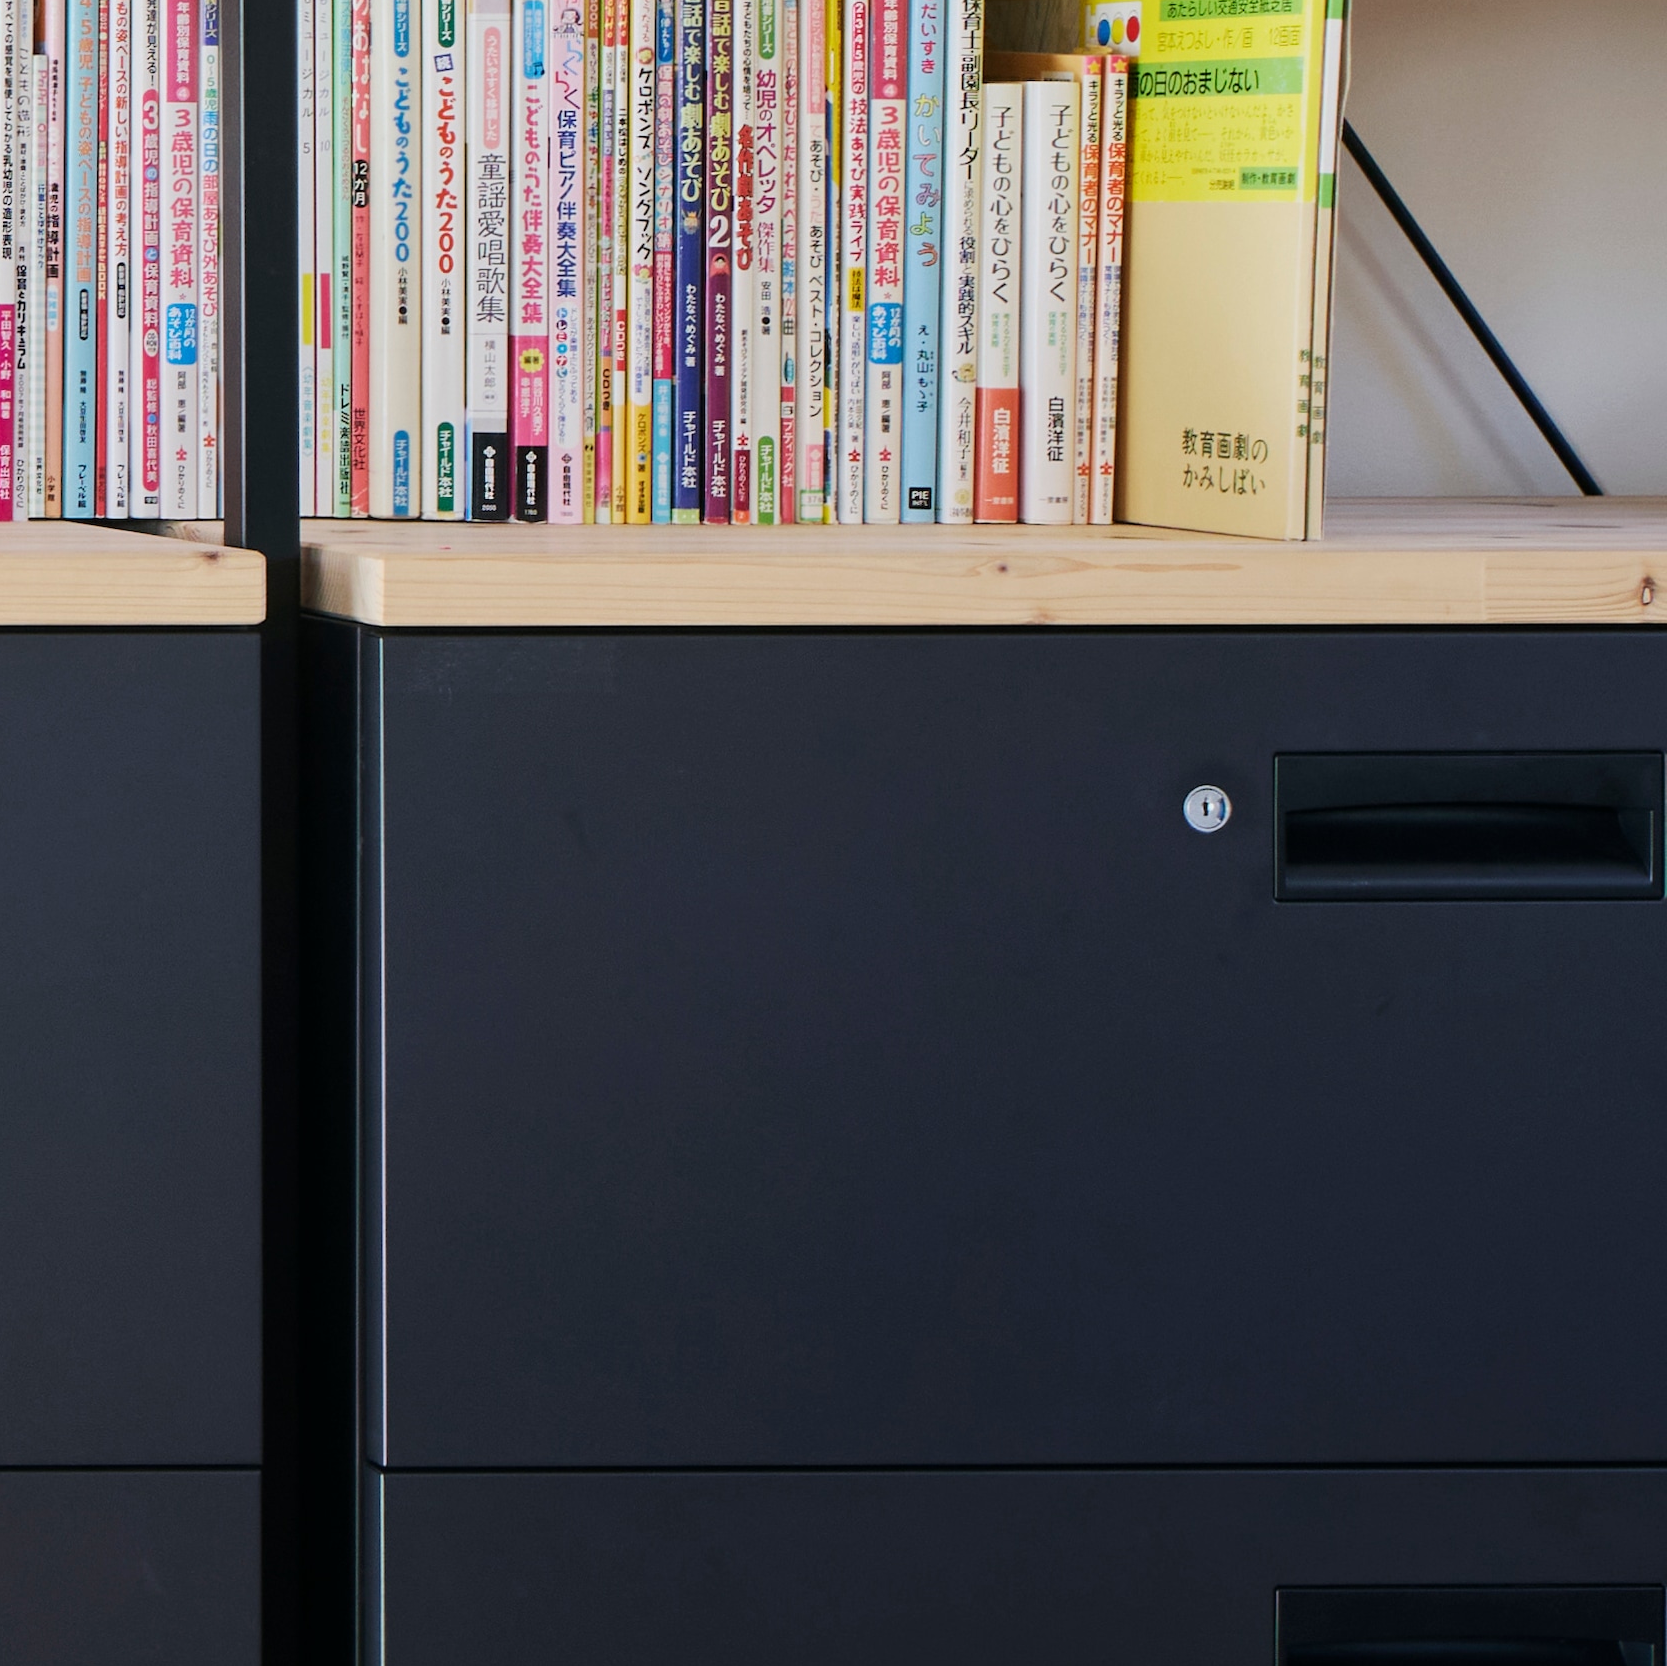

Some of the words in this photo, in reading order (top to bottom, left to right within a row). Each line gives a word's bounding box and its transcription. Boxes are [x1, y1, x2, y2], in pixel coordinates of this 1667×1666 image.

[170, 108, 193, 288] 3歳児の保育資料
[392, 67, 412, 262] こどものうた200
[436, 76, 458, 274] こどものうた200
[556, 109, 577, 298] 保育ピアノ伴奏大全集
[756, 69, 778, 214] 幼児のオペレッタ
[875, 106, 901, 287] 3歳児の保育資料
[910, 93, 940, 267] かいてみよう
[989, 105, 1015, 304] 子どもの心をひらく
[1047, 104, 1073, 303] 子どもの心をひらく
[1078, 144, 1100, 264] 保育者のマナー
[1105, 142, 1127, 263] 保育者のマナー
[476, 153, 506, 323] 童謡愛唱歌集
[709, 214, 731, 247] 2
[681, 411, 697, 488] チャイルド本社
[711, 420, 726, 497] チャイルド本社
[759, 444, 773, 513] チャイルド本社
[1182, 428, 1268, 464] 教育画劇の
[1182, 464, 1266, 495] かみしばい
